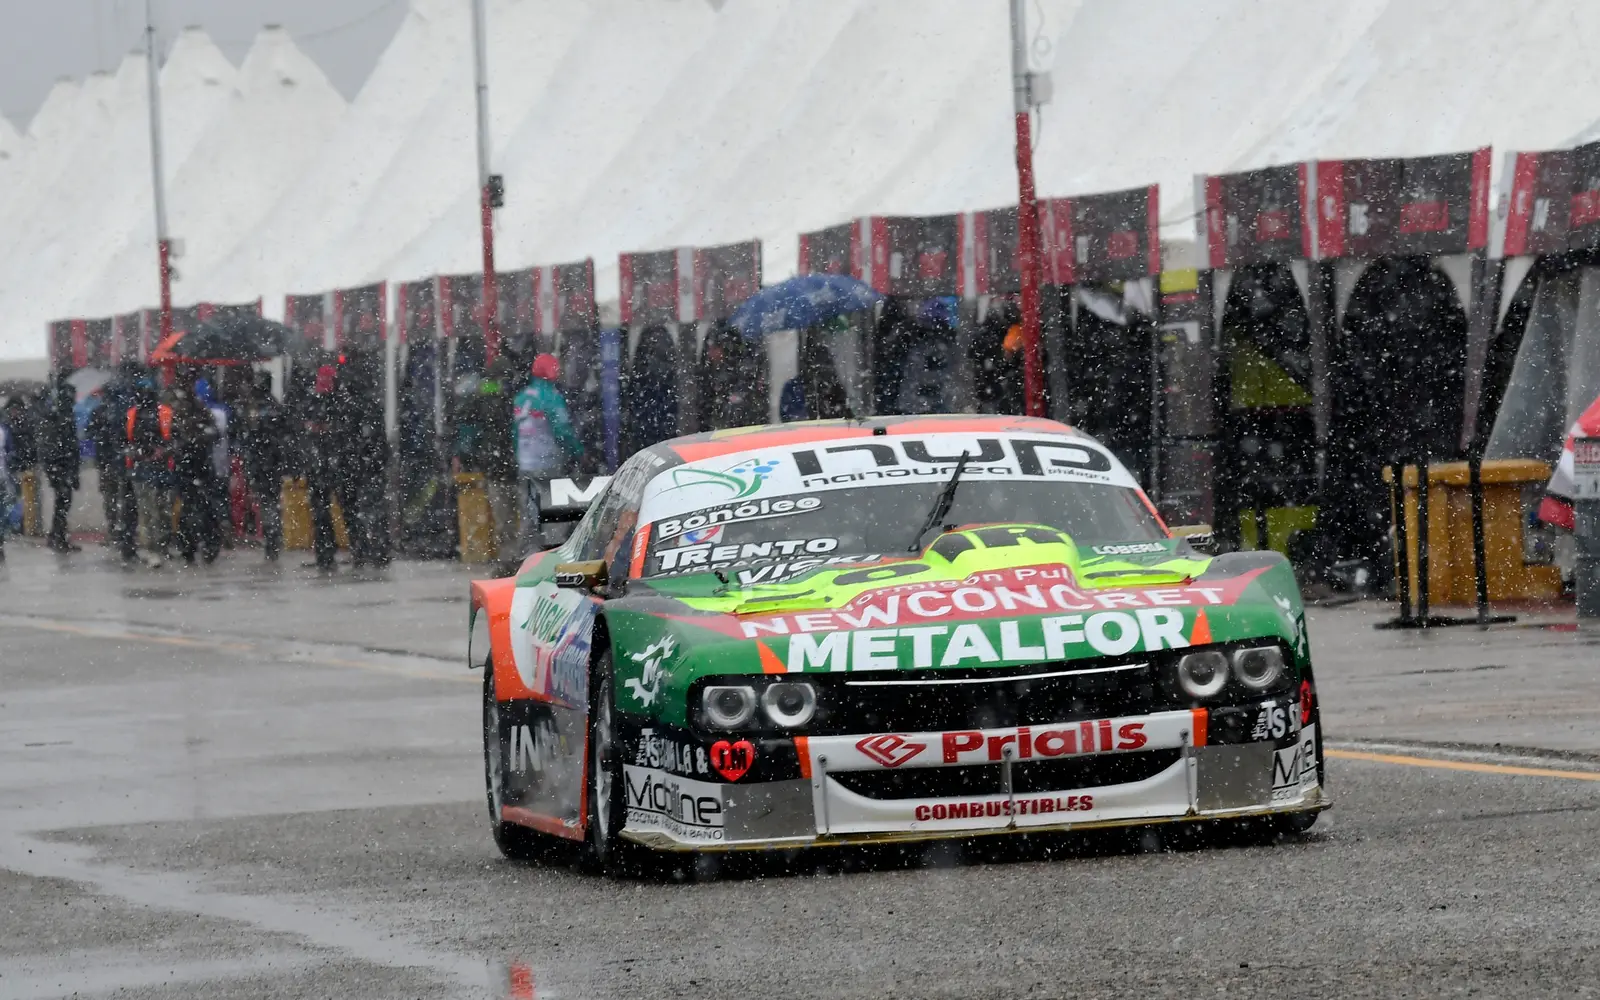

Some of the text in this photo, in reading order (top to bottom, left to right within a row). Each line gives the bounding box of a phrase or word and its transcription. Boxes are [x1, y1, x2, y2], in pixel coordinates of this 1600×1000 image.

[658, 497, 822, 540] Bonóleo
[655, 537, 838, 571] TRENTO
[1092, 543, 1168, 555] LOBERIA
[737, 583, 1227, 639] NEWCONCRET
[787, 607, 1191, 674] METALFOR
[942, 720, 1148, 764] Prialis
[915, 795, 1094, 822] COMBUSTIBLES
